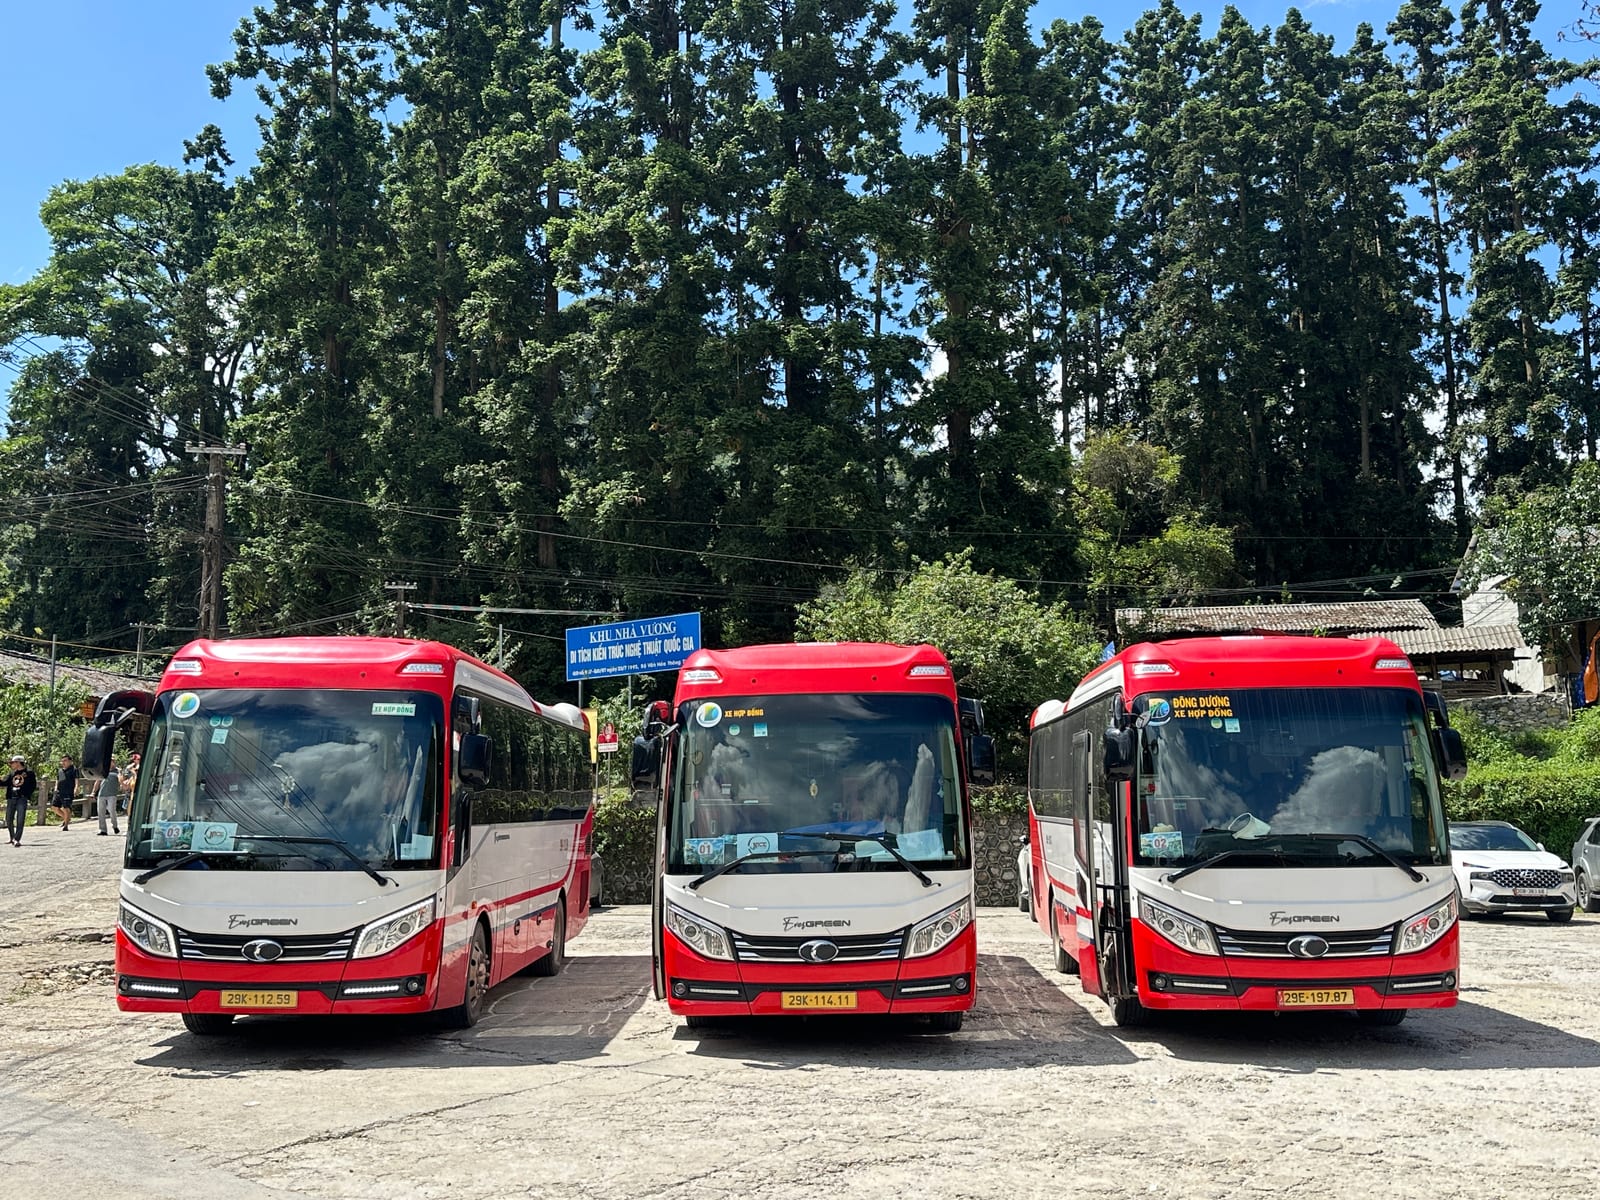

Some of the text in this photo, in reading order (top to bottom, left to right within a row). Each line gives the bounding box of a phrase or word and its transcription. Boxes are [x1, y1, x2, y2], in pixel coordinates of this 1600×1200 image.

[590, 621, 676, 643] KHU NHÀ VƯƠNG
[570, 635, 694, 664] DI TÍCH KIẾN TRÚC NGHỆ THUẬT QUỐC GIA
[1172, 696, 1197, 709] ĐÔNG
[724, 710, 733, 718] XE
[1174, 707, 1233, 719] XE HỢP ĐỒNG
[167, 828, 180, 838] 03
[1154, 838, 1167, 849] 02
[699, 845, 711, 855] 01
